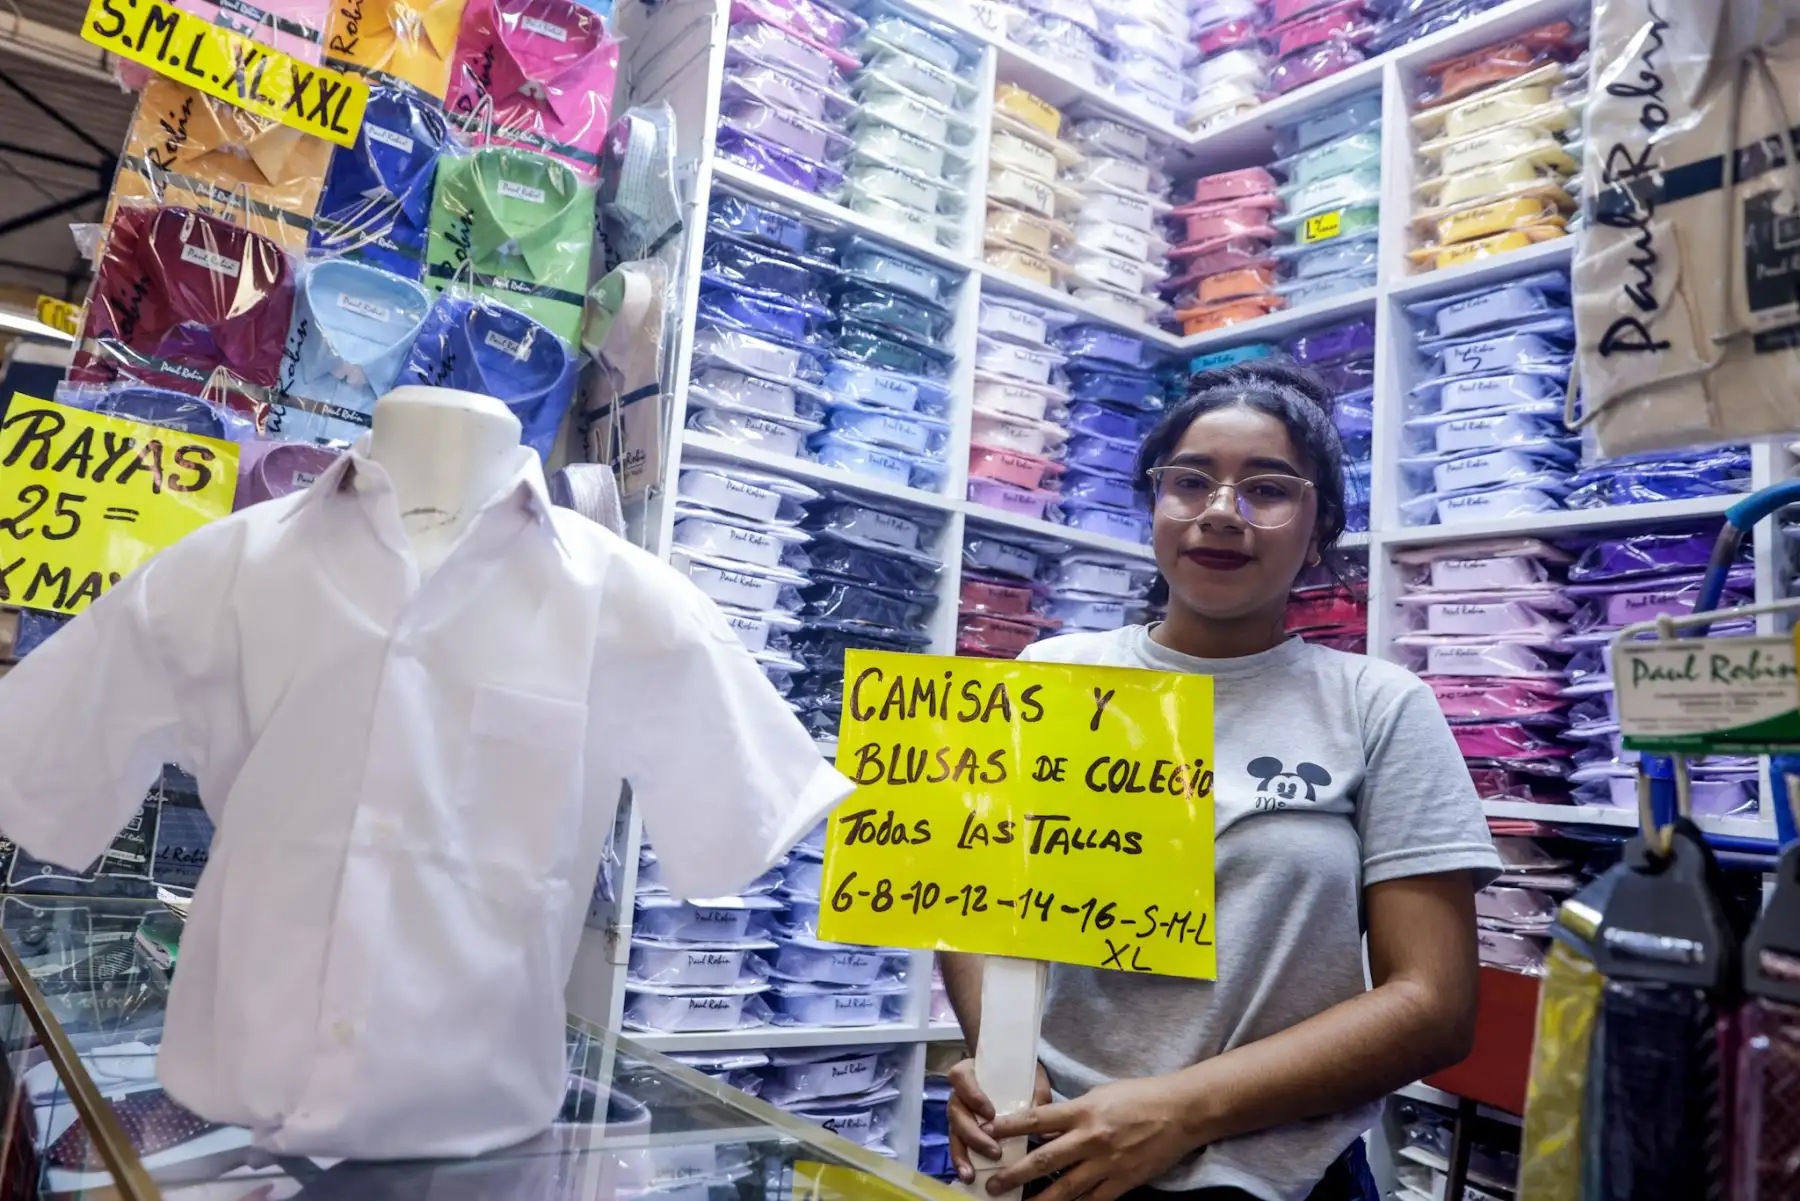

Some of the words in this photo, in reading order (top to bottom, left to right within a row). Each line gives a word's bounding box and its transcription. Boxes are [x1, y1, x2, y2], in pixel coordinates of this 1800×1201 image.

[147, 95, 193, 172] Robin
[160, 360, 182, 376] Paul
[182, 367, 205, 381] Robin
[322, 403, 341, 417] Paul
[341, 409, 364, 422] Robin
[0, 410, 216, 494] RAYAS
[0, 484, 87, 541] 25
[1631, 653, 1699, 689] Paul
[1709, 648, 1798, 684] Robin
[1090, 685, 1116, 732] Y
[849, 742, 1009, 786] BLUSAS
[1031, 754, 1069, 783] DE
[956, 810, 1016, 850] LAS
[1024, 813, 1144, 856] TALLAS
[688, 954, 707, 967] Paul
[707, 954, 731, 965] Robin
[1100, 938, 1154, 973] XL
[689, 998, 708, 1011] Paul
[708, 998, 731, 1010] Robin
